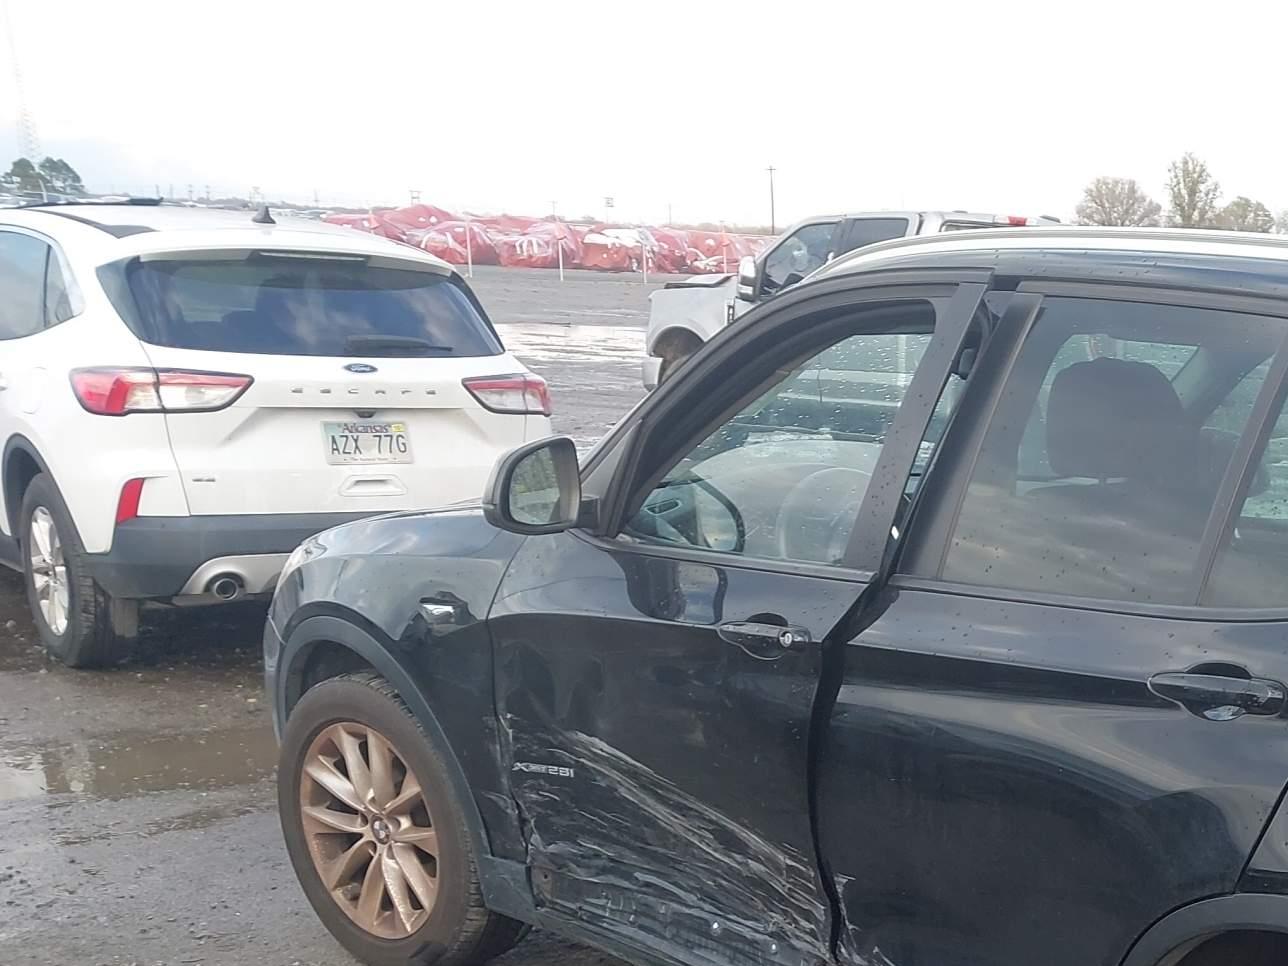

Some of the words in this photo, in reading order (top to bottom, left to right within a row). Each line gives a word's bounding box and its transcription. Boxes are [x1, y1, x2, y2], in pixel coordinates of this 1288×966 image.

[343, 423, 389, 433] Arkansas
[331, 434, 362, 455] AZX
[372, 434, 407, 454] 77G
